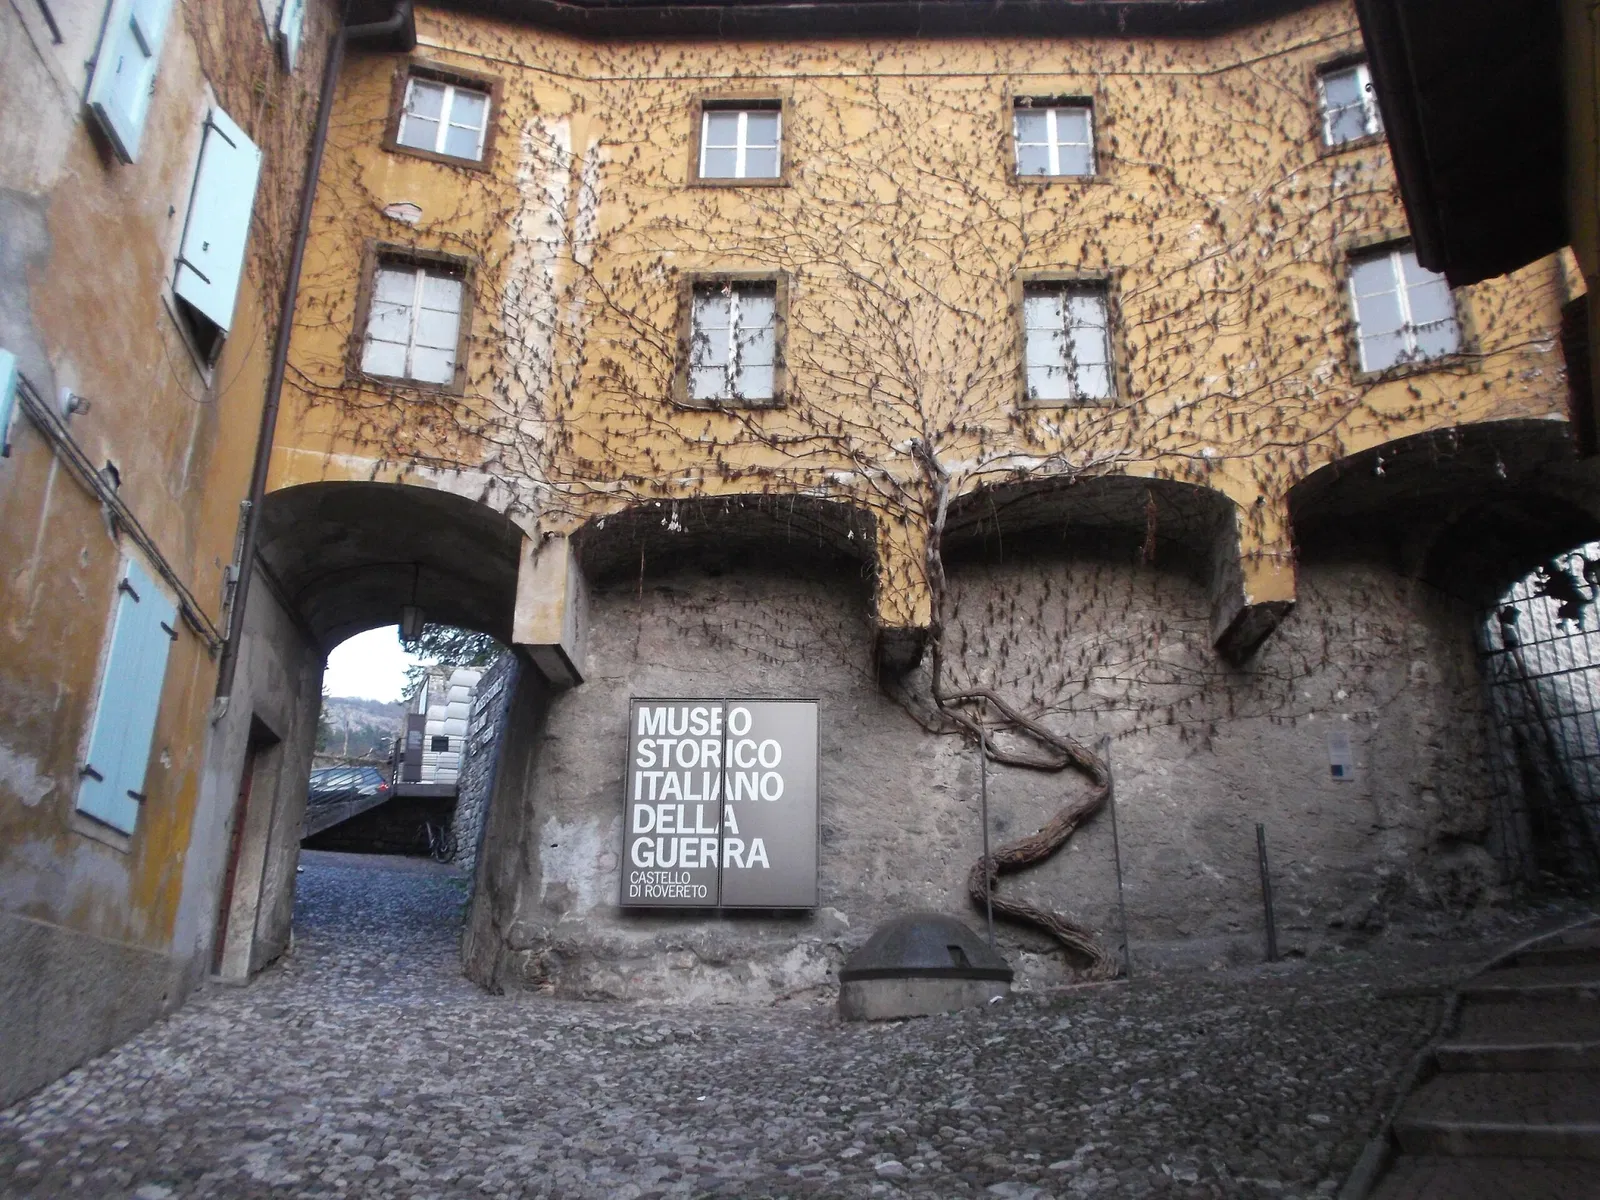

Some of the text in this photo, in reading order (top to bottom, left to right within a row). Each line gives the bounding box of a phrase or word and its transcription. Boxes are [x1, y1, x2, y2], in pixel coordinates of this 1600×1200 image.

[637, 707, 752, 736] MUSEO
[636, 738, 782, 768] STORICO
[634, 771, 784, 801] ITALIANO
[632, 804, 740, 835] DELLA
[631, 837, 770, 869] GUERRA
[629, 885, 708, 899] DI ROVERETO
[630, 871, 691, 885] CASTELLO
